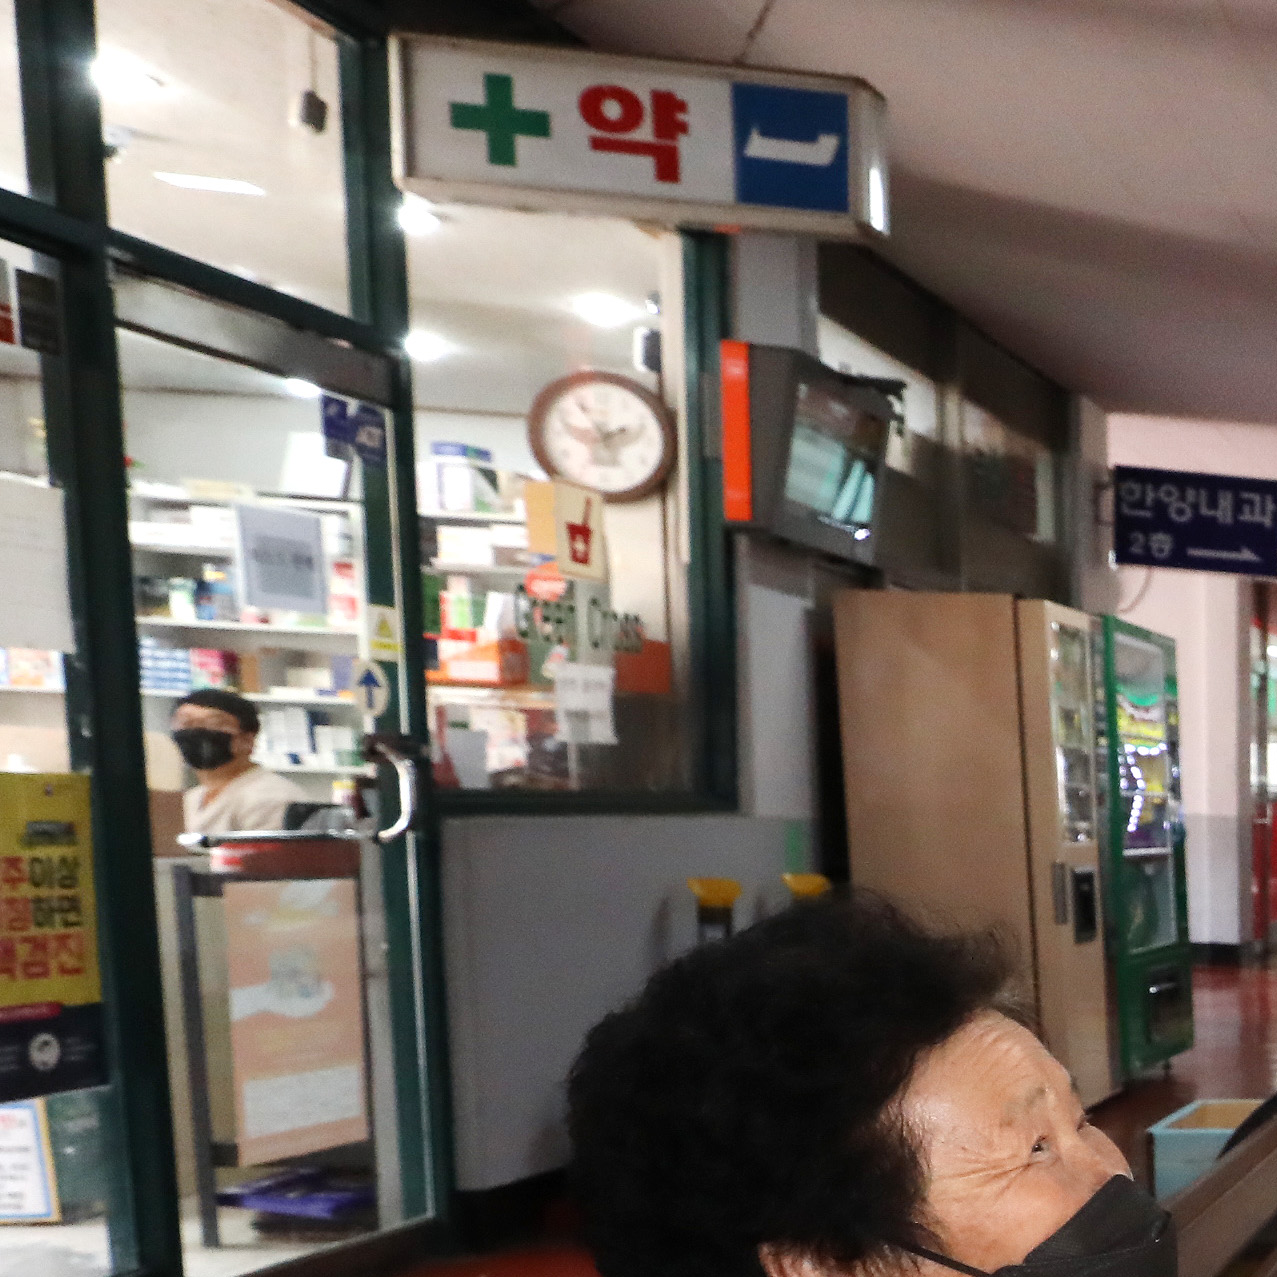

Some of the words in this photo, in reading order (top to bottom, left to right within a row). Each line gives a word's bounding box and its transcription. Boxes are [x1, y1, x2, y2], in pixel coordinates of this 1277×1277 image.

[578, 84, 690, 184] 약
[1120, 481, 1277, 529] 한양내과
[1129, 530, 1174, 559] 2층
[29, 855, 81, 890] 이상
